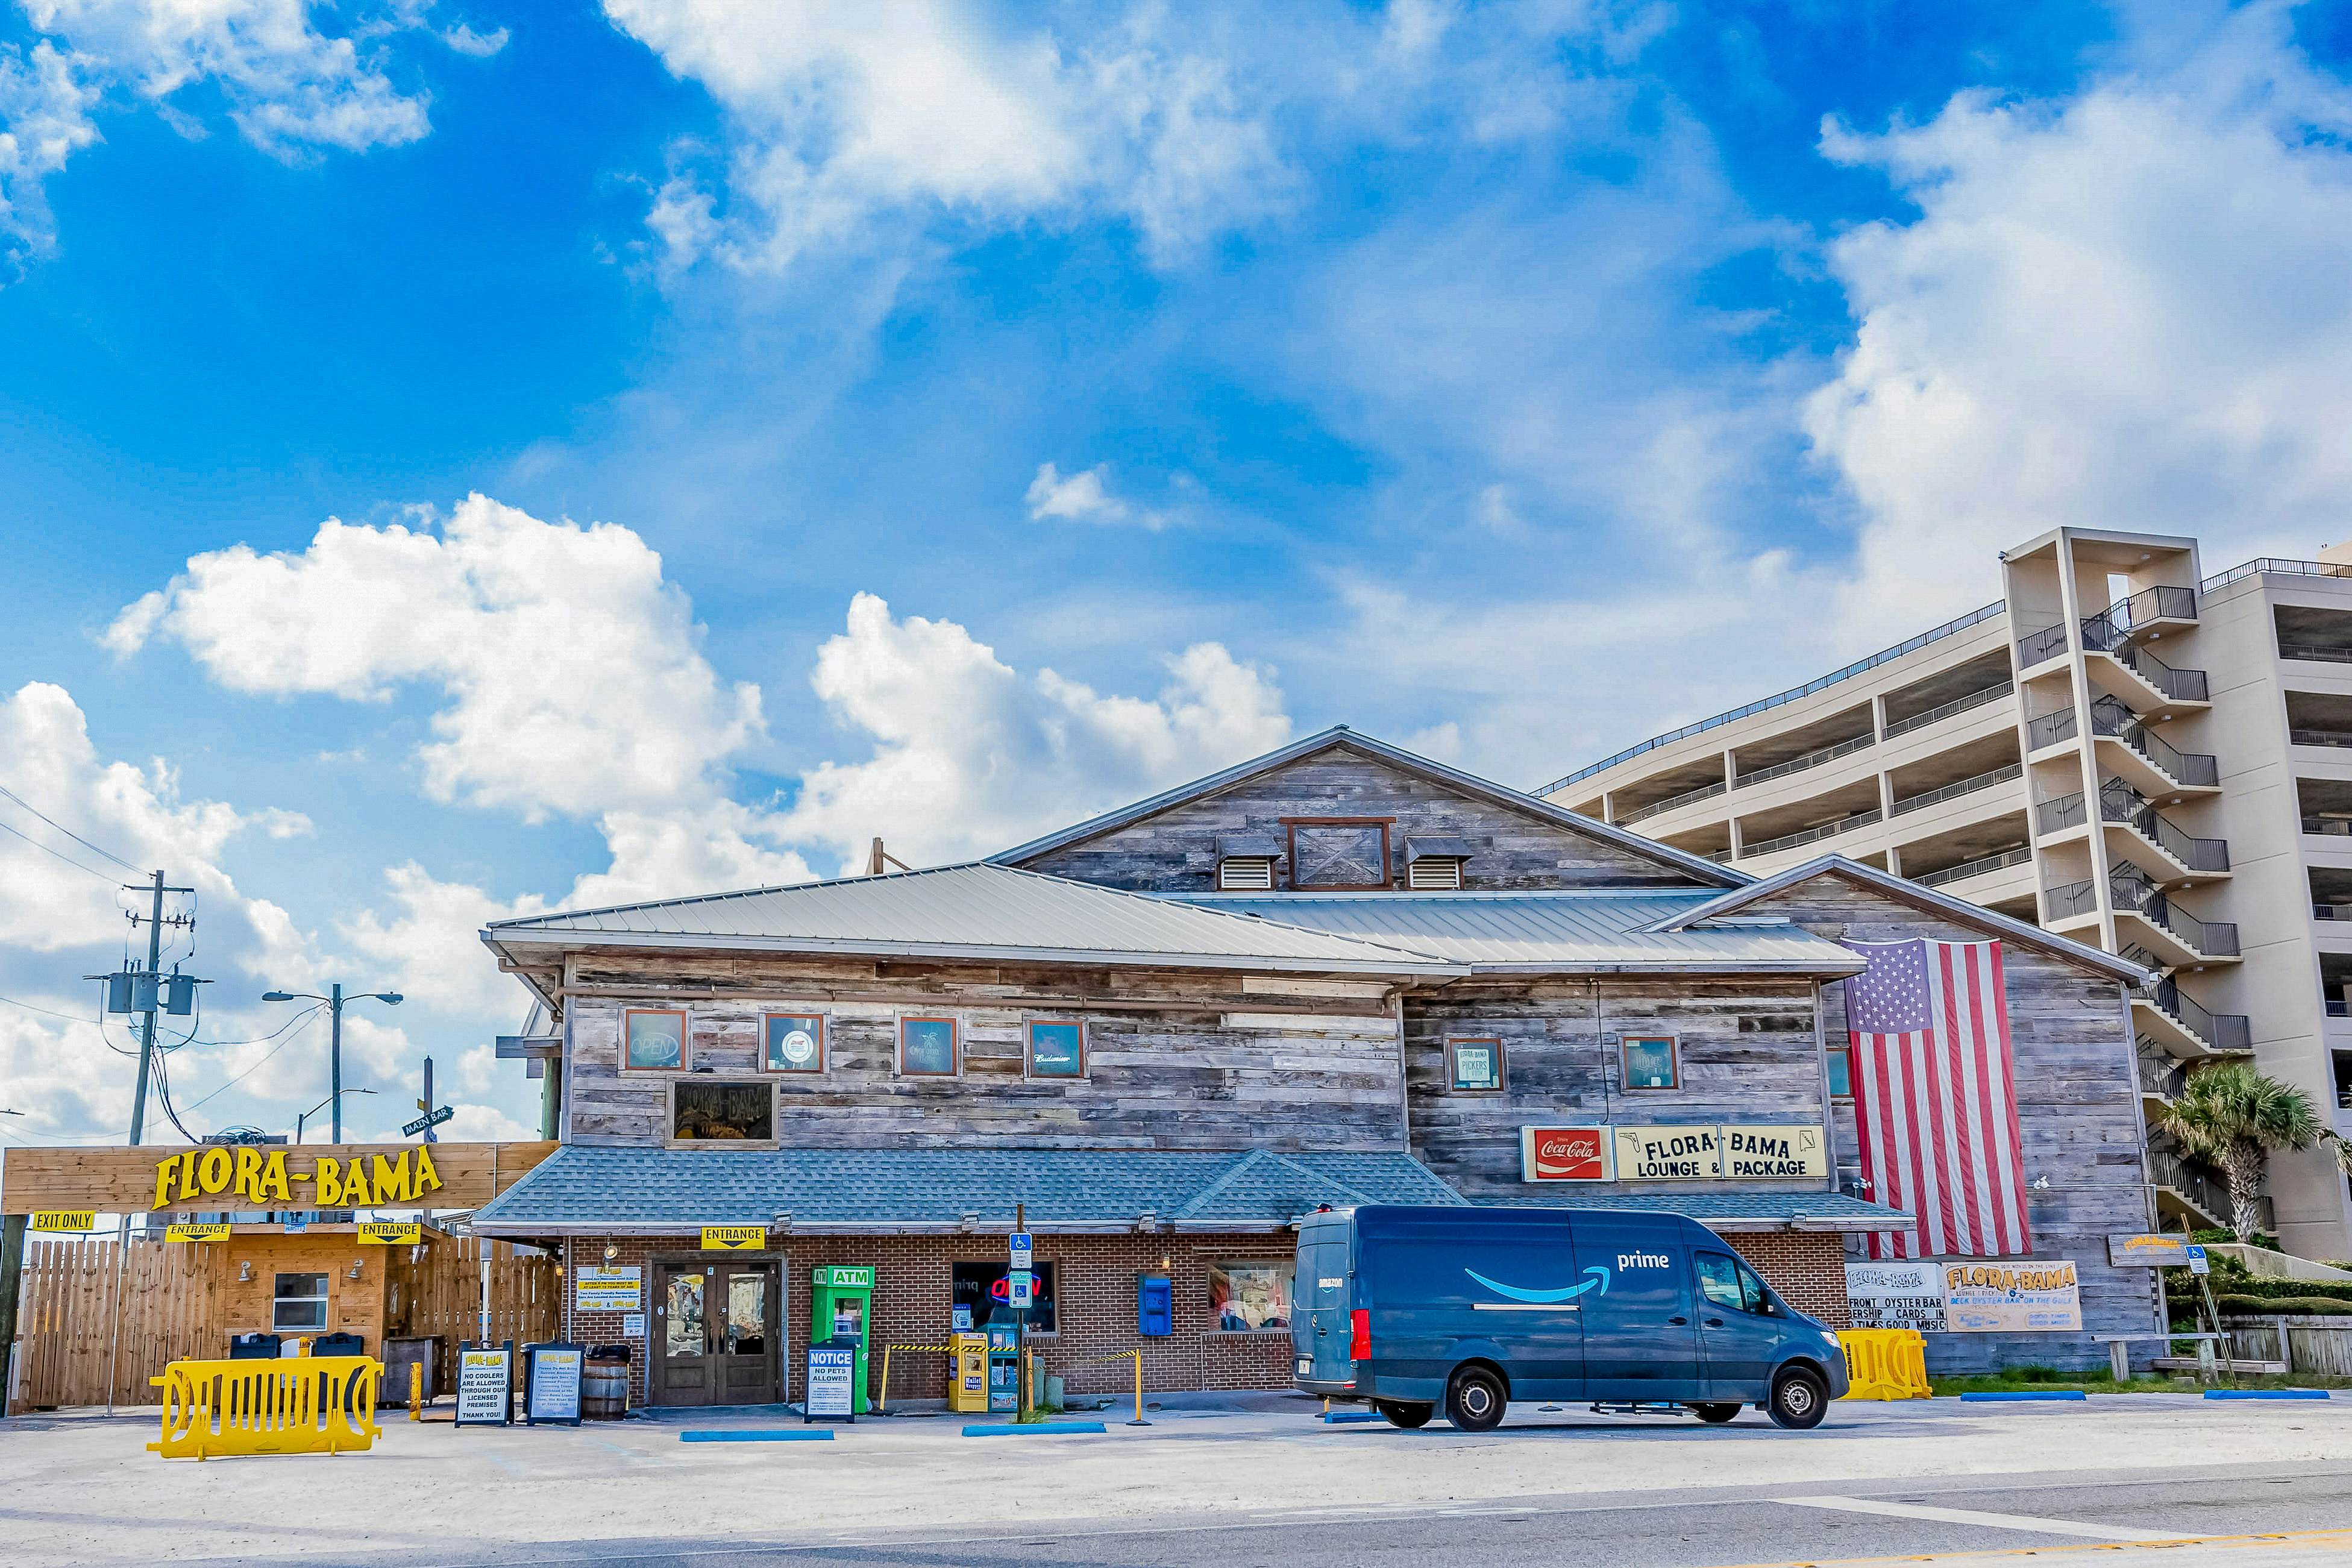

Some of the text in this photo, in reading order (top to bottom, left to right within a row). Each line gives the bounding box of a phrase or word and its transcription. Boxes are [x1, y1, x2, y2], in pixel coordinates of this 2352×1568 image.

[631, 1037, 671, 1055] OPEN
[1033, 1054, 1070, 1062] Budweiser
[1462, 1061, 1487, 1070] PICKERS
[406, 1109, 448, 1134] MAIN BAR
[1541, 1140, 1596, 1158] Coca-Cola
[1637, 1161, 1807, 1178] LOUNGE & PACKAGE
[150, 1144, 444, 1211] FLORA-BAMA
[36, 1214, 92, 1228] EXIT ONLY
[171, 1225, 227, 1234] ENTRANCE
[362, 1225, 417, 1235] ENTRANCE
[706, 1229, 760, 1239] ENTRANCE
[1617, 1249, 1670, 1272] prime
[815, 1270, 826, 1282] ATM
[835, 1271, 867, 1283] ATM
[1851, 1269, 1924, 1288] FLORA-BAMA
[1946, 1266, 2075, 1291] FLORA-BAMA
[1319, 1278, 1343, 1288] amazon
[1849, 1298, 1877, 1308] FRONT
[1896, 1309, 1926, 1319] CARDS
[1936, 1309, 1944, 1319] IN
[1886, 1320, 1910, 1329] GOOD
[1916, 1320, 1945, 1329] MUSIC
[811, 1352, 851, 1364] NOTICE
